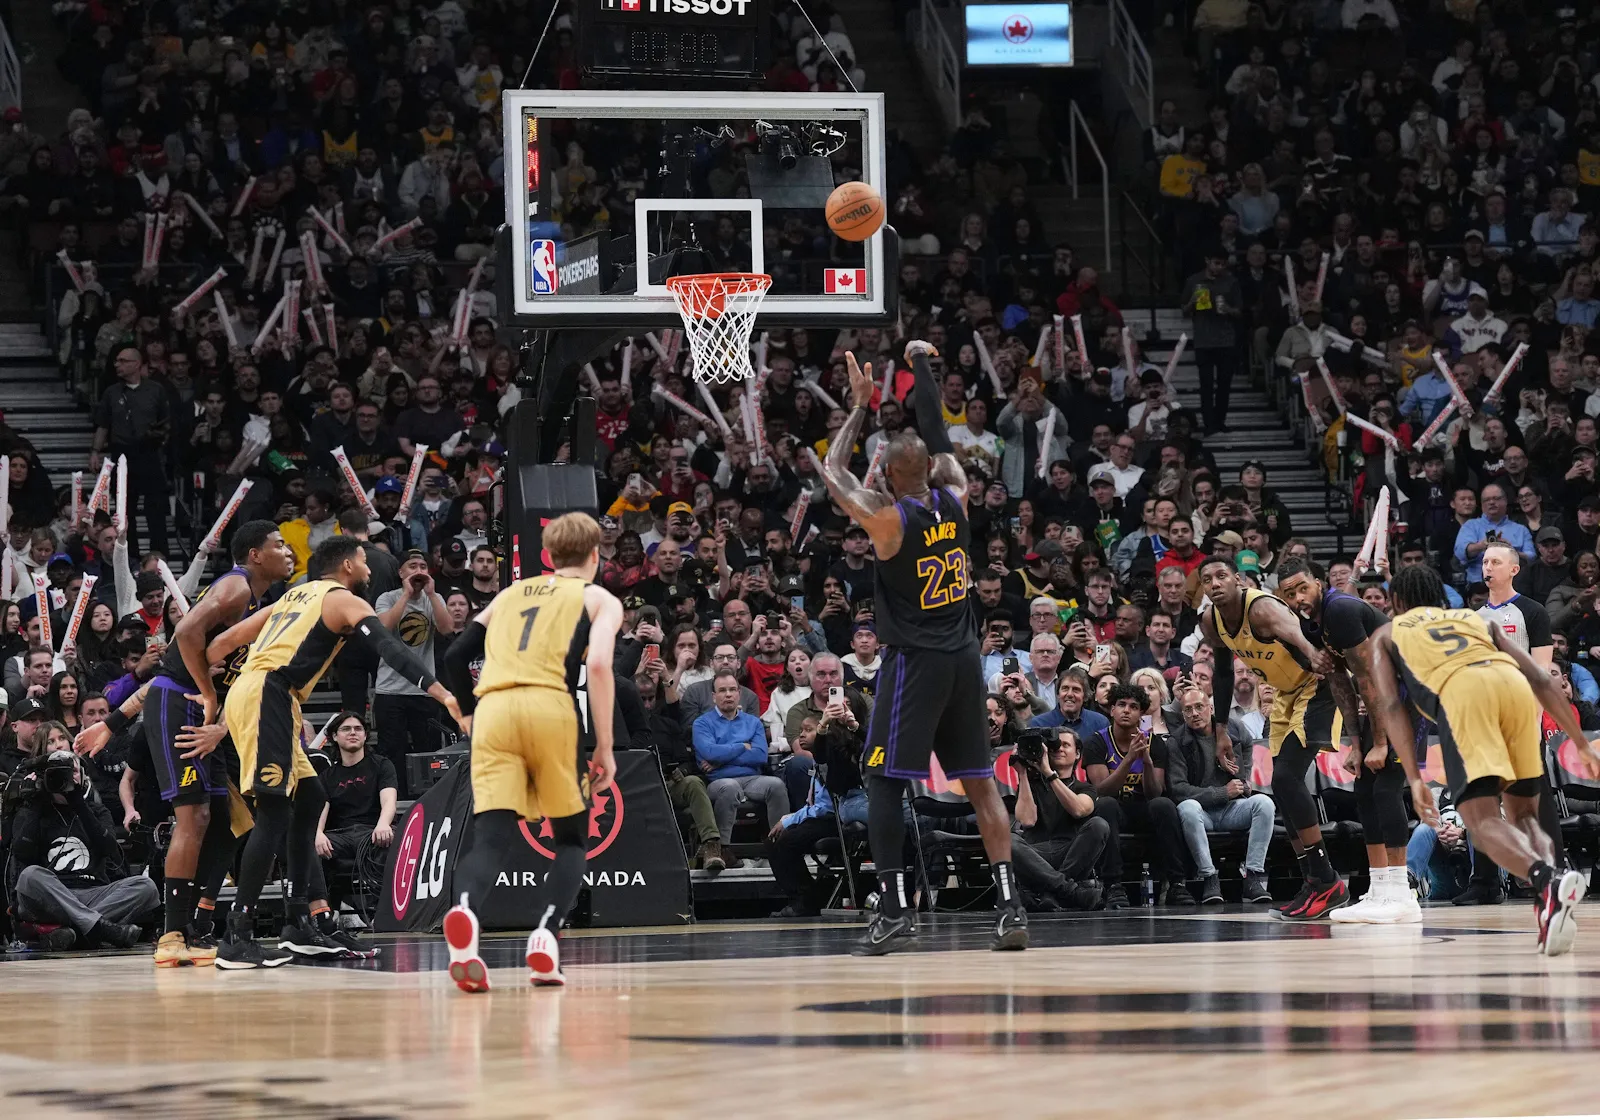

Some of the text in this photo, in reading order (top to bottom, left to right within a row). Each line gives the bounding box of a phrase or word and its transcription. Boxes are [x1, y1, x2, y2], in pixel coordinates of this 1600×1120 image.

[650, 0, 752, 15] TISSOT
[834, 203, 872, 224] Wilson
[535, 281, 548, 291] NBA
[558, 255, 599, 288] POKERSTARS
[923, 522, 956, 547] JAMES
[916, 547, 967, 610] 23
[37, 591, 51, 640] pizza pizza
[69, 592, 89, 640] pizza pizza
[518, 606, 541, 651] 1
[256, 612, 302, 652] 17
[1426, 625, 1469, 656] 5
[866, 746, 886, 768] LA
[179, 765, 198, 788] LA
[415, 816, 452, 900] LG
[495, 870, 647, 887] AIR NADA
